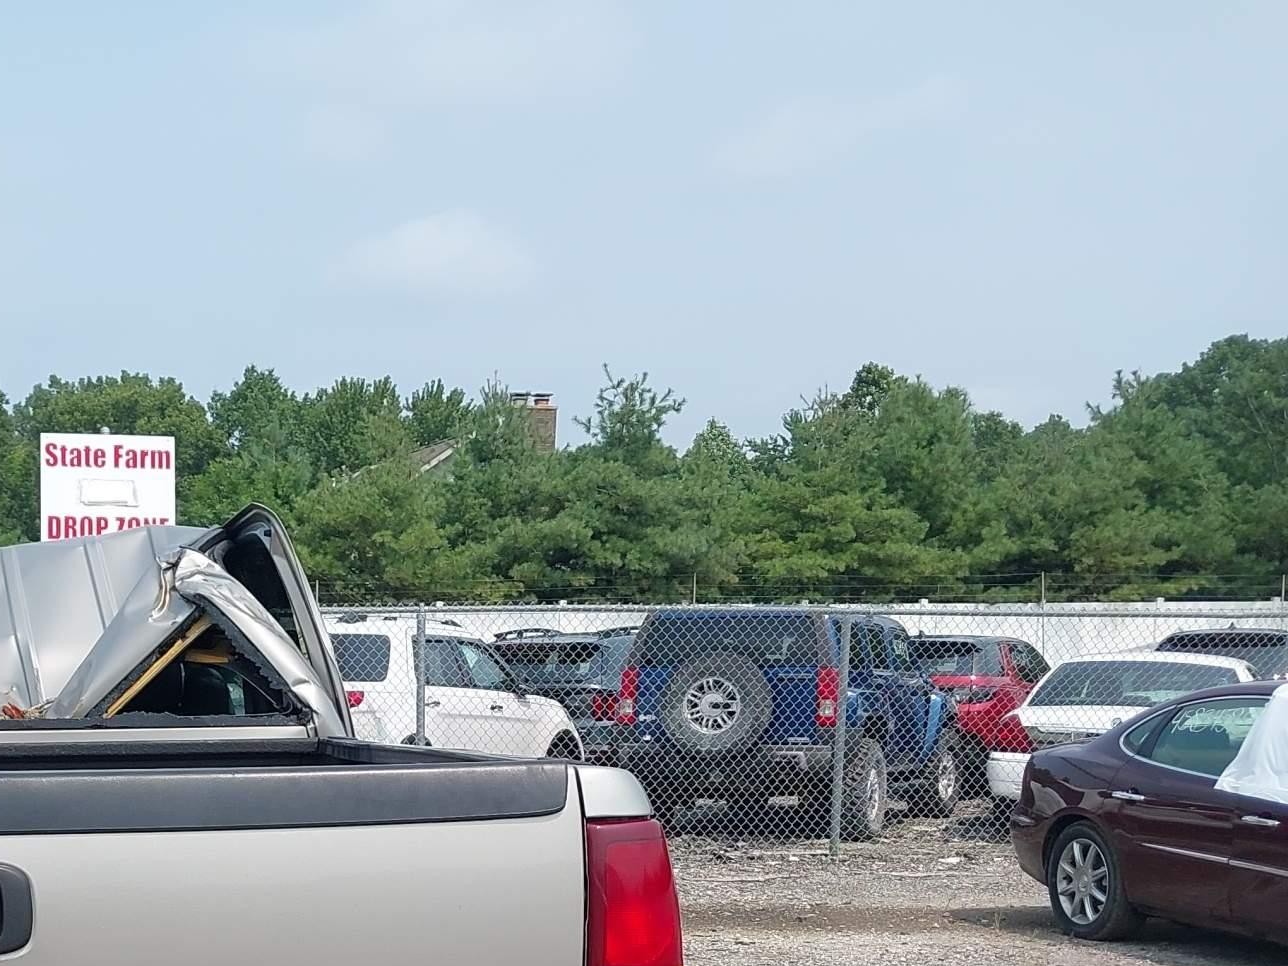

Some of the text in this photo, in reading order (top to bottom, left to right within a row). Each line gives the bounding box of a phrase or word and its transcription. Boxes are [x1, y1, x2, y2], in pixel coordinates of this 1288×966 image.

[45, 442, 171, 469] State Farm
[48, 515, 109, 539] DROP
